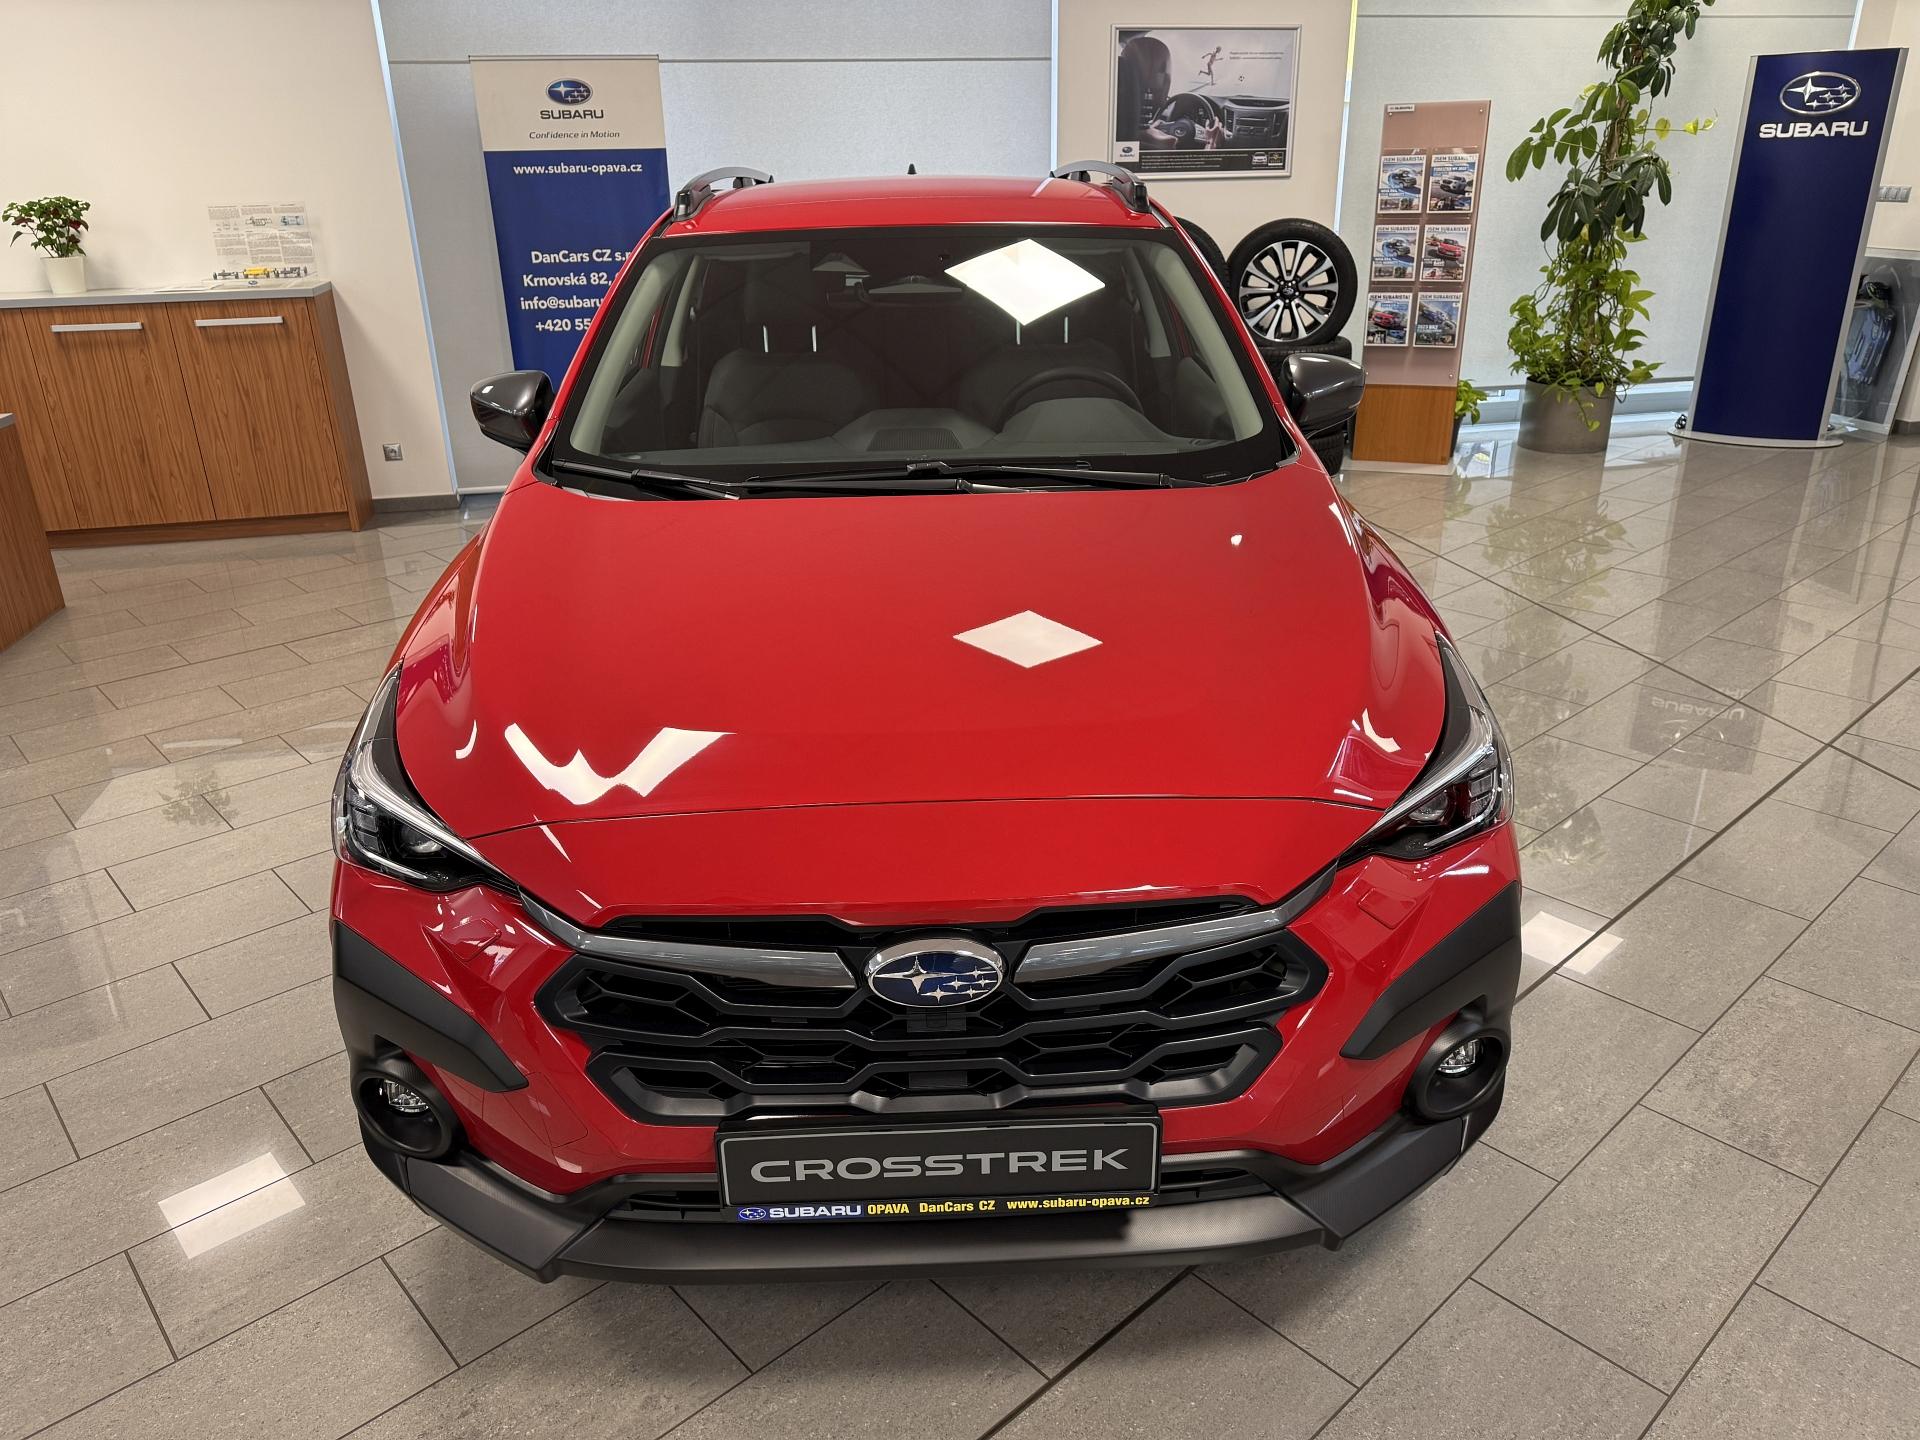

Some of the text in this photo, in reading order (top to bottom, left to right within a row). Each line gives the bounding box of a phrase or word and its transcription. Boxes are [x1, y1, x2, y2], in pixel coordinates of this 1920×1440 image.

[540, 109, 604, 119] SUBARU
[529, 130, 620, 139] Confidence in Motion
[1759, 121, 1868, 138] SUBARU
[513, 162, 643, 175] www.subaru-opava.cz
[531, 250, 589, 263] DanCars
[592, 249, 612, 261] CZ
[523, 272, 612, 287] Krnovská 82,
[535, 319, 571, 332] +420
[750, 1148, 1129, 1183] CROSSTREK
[769, 1195, 1150, 1219] SUBARU OPAVA DanCars CZ www.subaru-opava.cz
